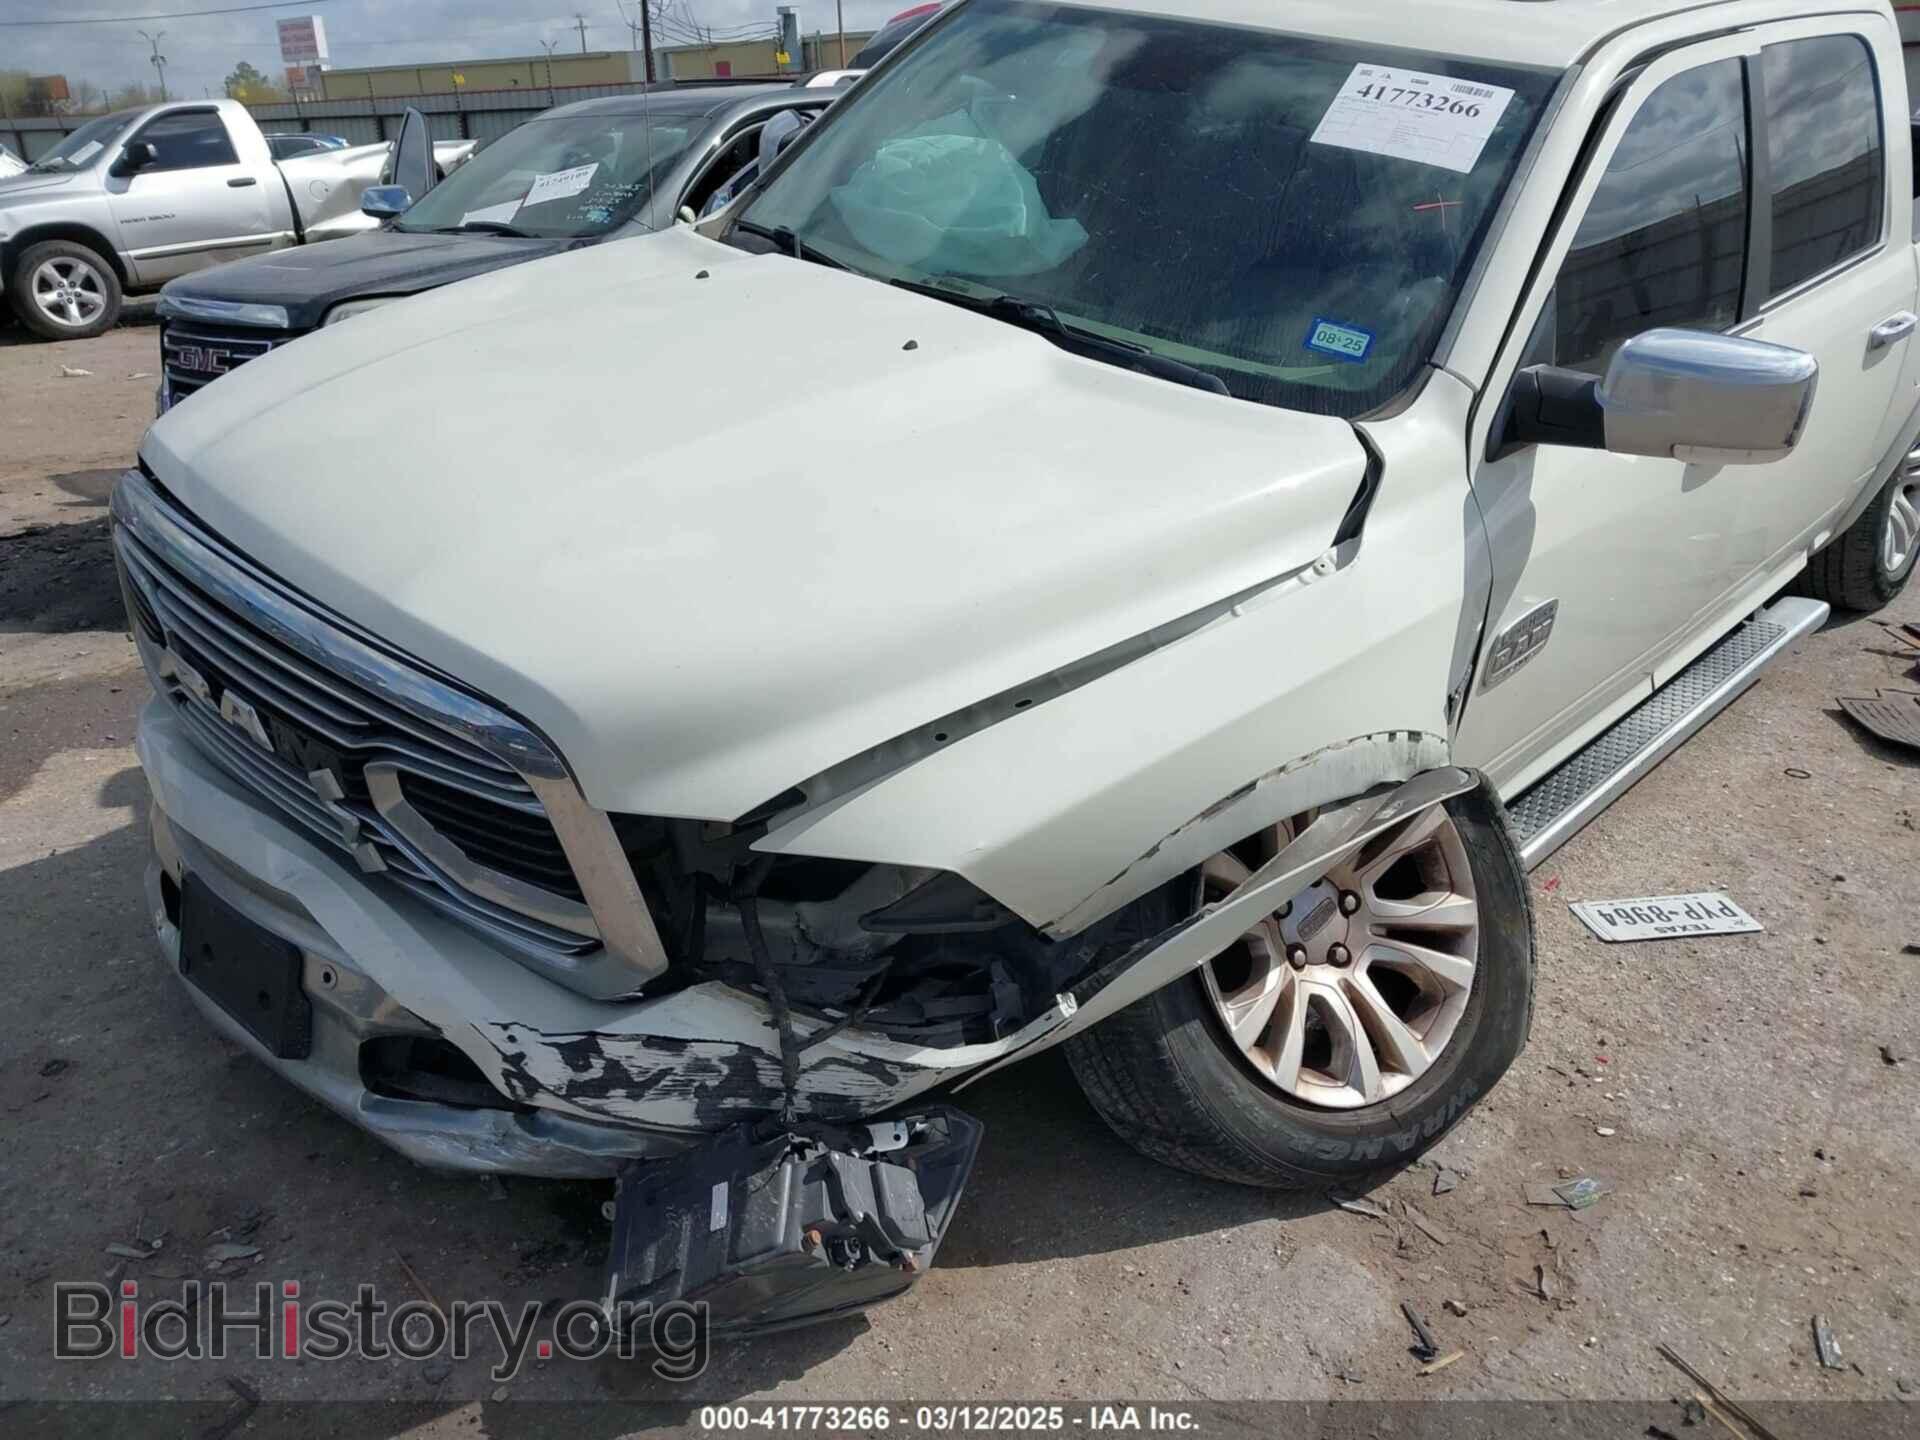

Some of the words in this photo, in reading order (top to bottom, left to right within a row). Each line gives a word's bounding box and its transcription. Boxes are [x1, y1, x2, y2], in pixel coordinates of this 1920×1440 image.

[1357, 82, 1483, 119] 41773266
[178, 345, 230, 374] GMC
[1653, 921, 1714, 934] TEXAS
